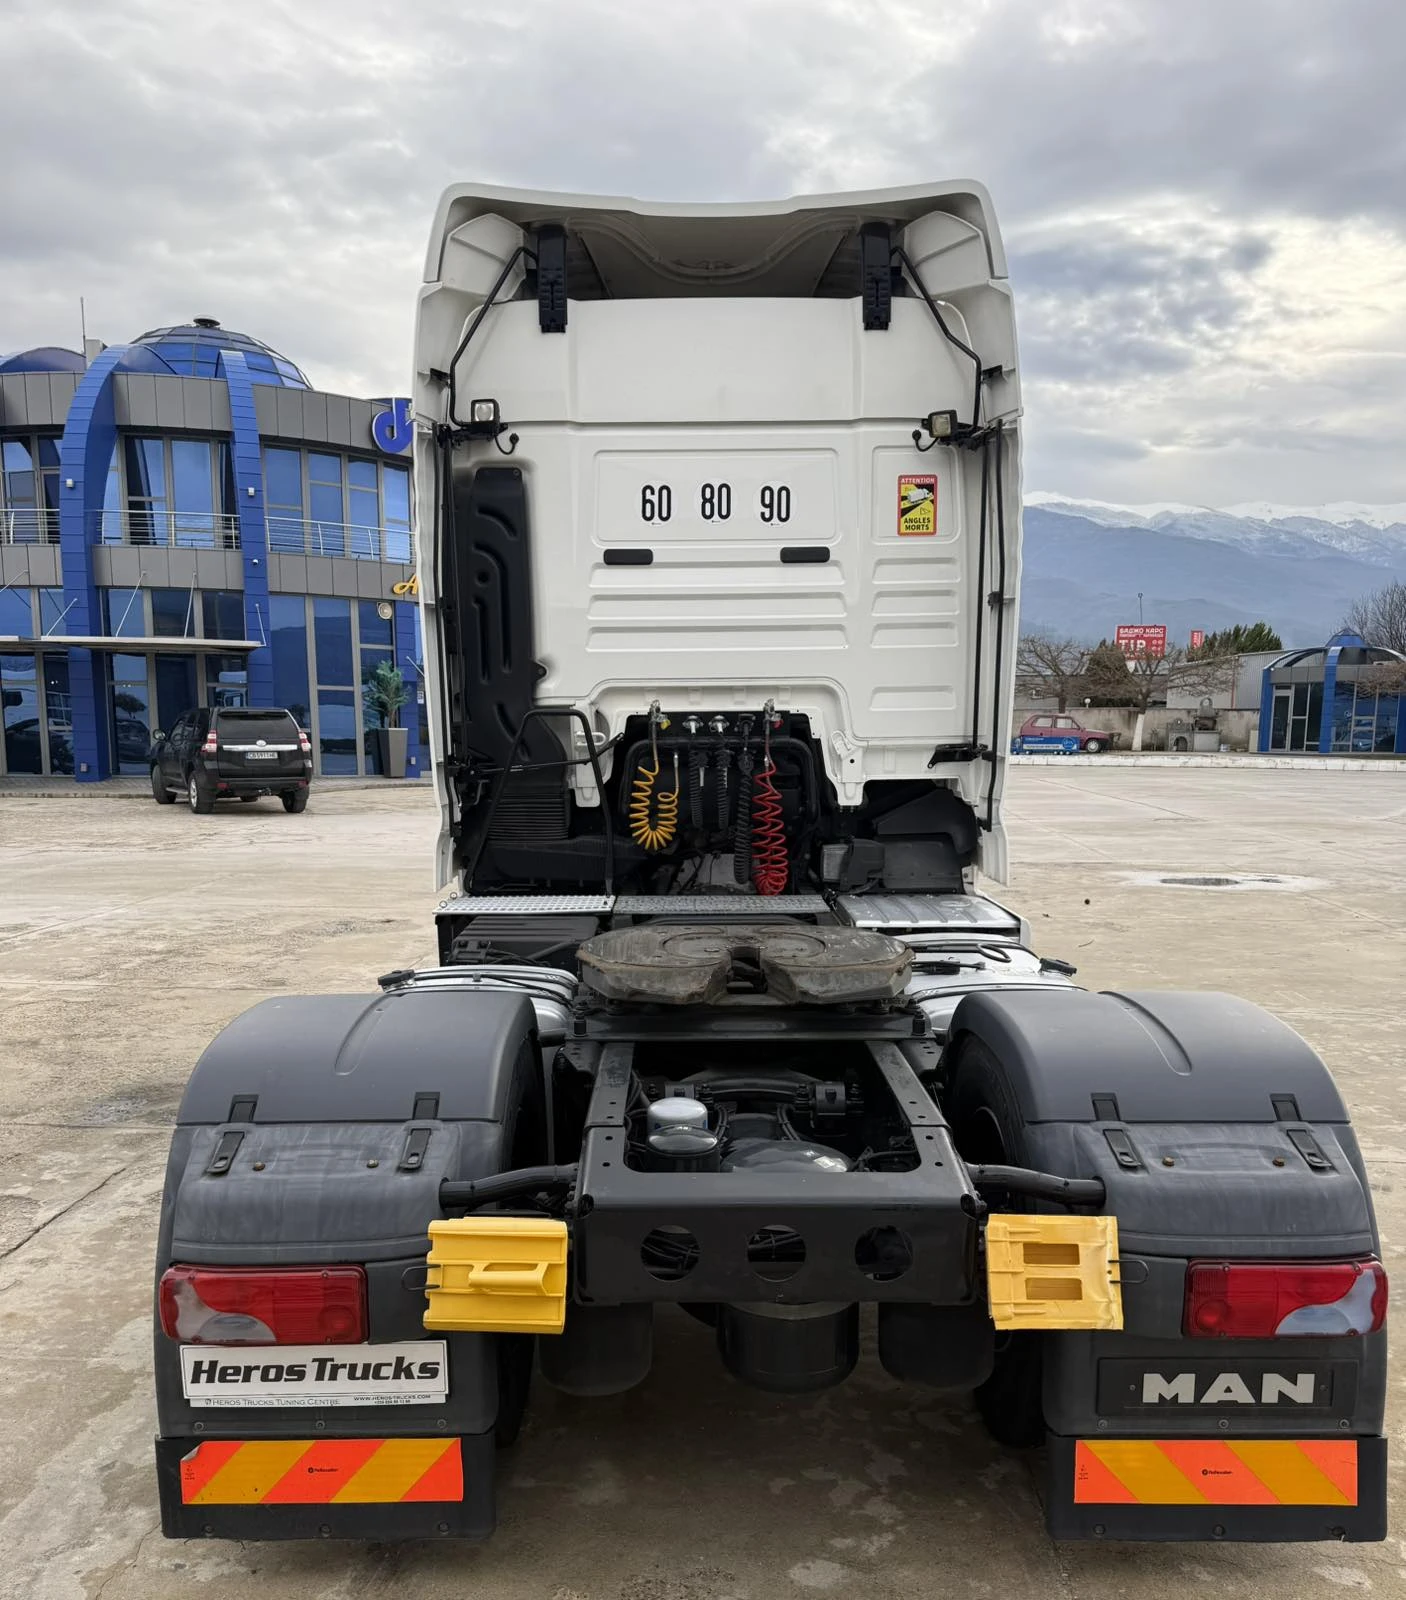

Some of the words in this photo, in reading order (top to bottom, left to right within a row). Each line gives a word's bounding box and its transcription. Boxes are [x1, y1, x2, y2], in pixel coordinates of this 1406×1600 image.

[641, 484, 672, 522] 60
[701, 483, 731, 520] 80
[760, 485, 791, 523] 90
[191, 1359, 307, 1384] Heros
[312, 1356, 440, 1381] Trucks
[243, 1398, 275, 1406] TRUCKS
[275, 1398, 305, 1406] TUNING
[1142, 1373, 1316, 1403] MAN
